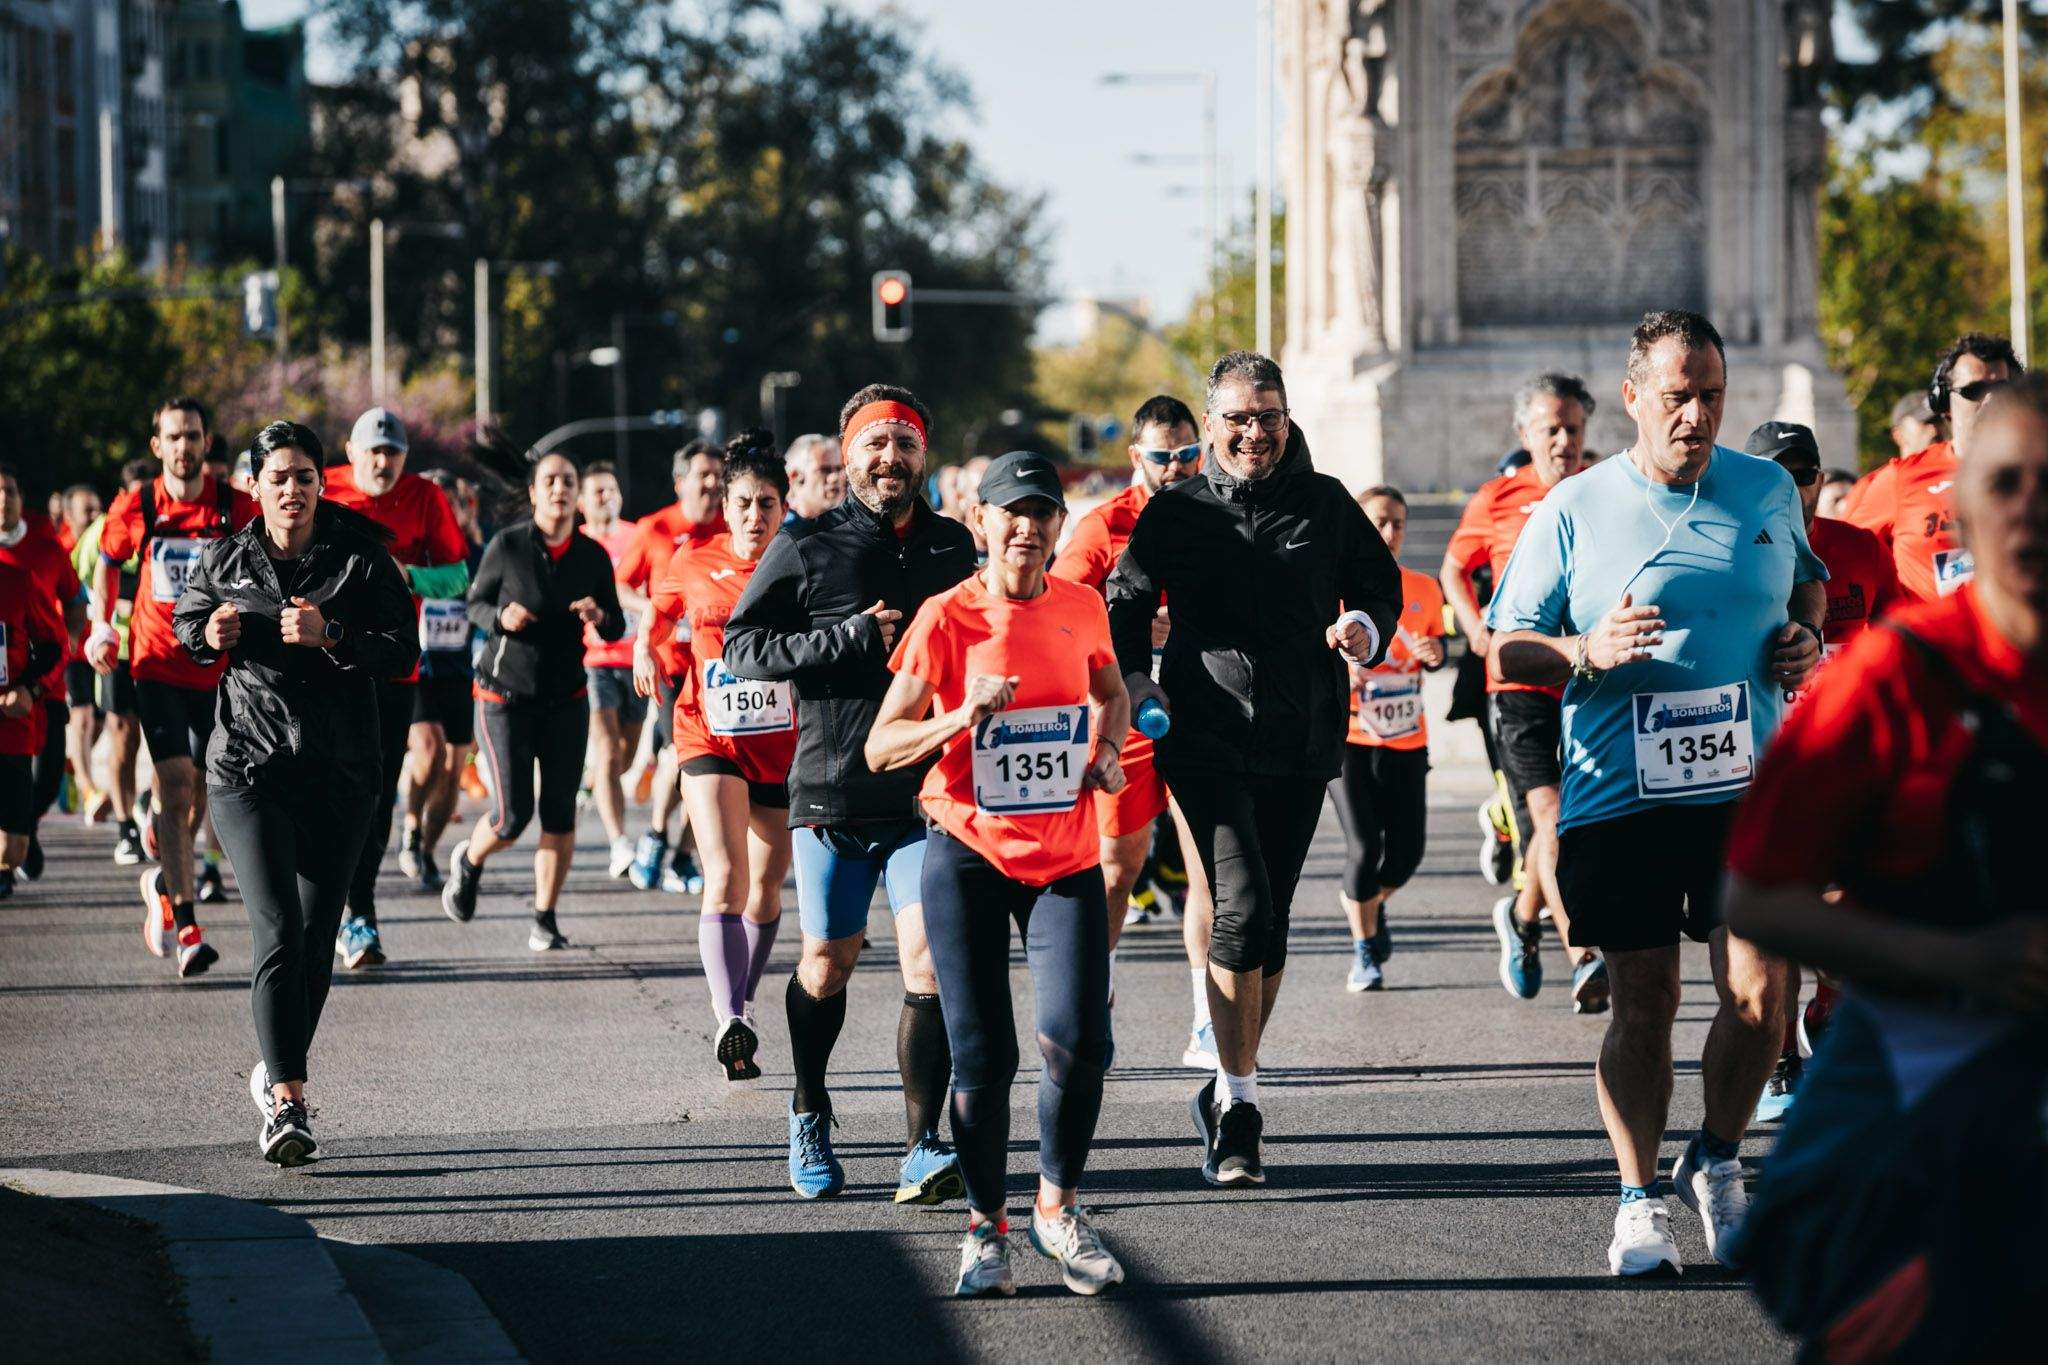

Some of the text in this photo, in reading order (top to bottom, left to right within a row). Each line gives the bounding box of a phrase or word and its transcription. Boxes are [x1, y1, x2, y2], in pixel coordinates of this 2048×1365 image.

[722, 688, 778, 712] 1504
[1374, 700, 1415, 721] 1013
[1671, 702, 1731, 718] BOMBEROS
[1010, 722, 1069, 734] BOMBEROS
[1659, 730, 1737, 766] 1354
[996, 750, 1069, 783] 1351
